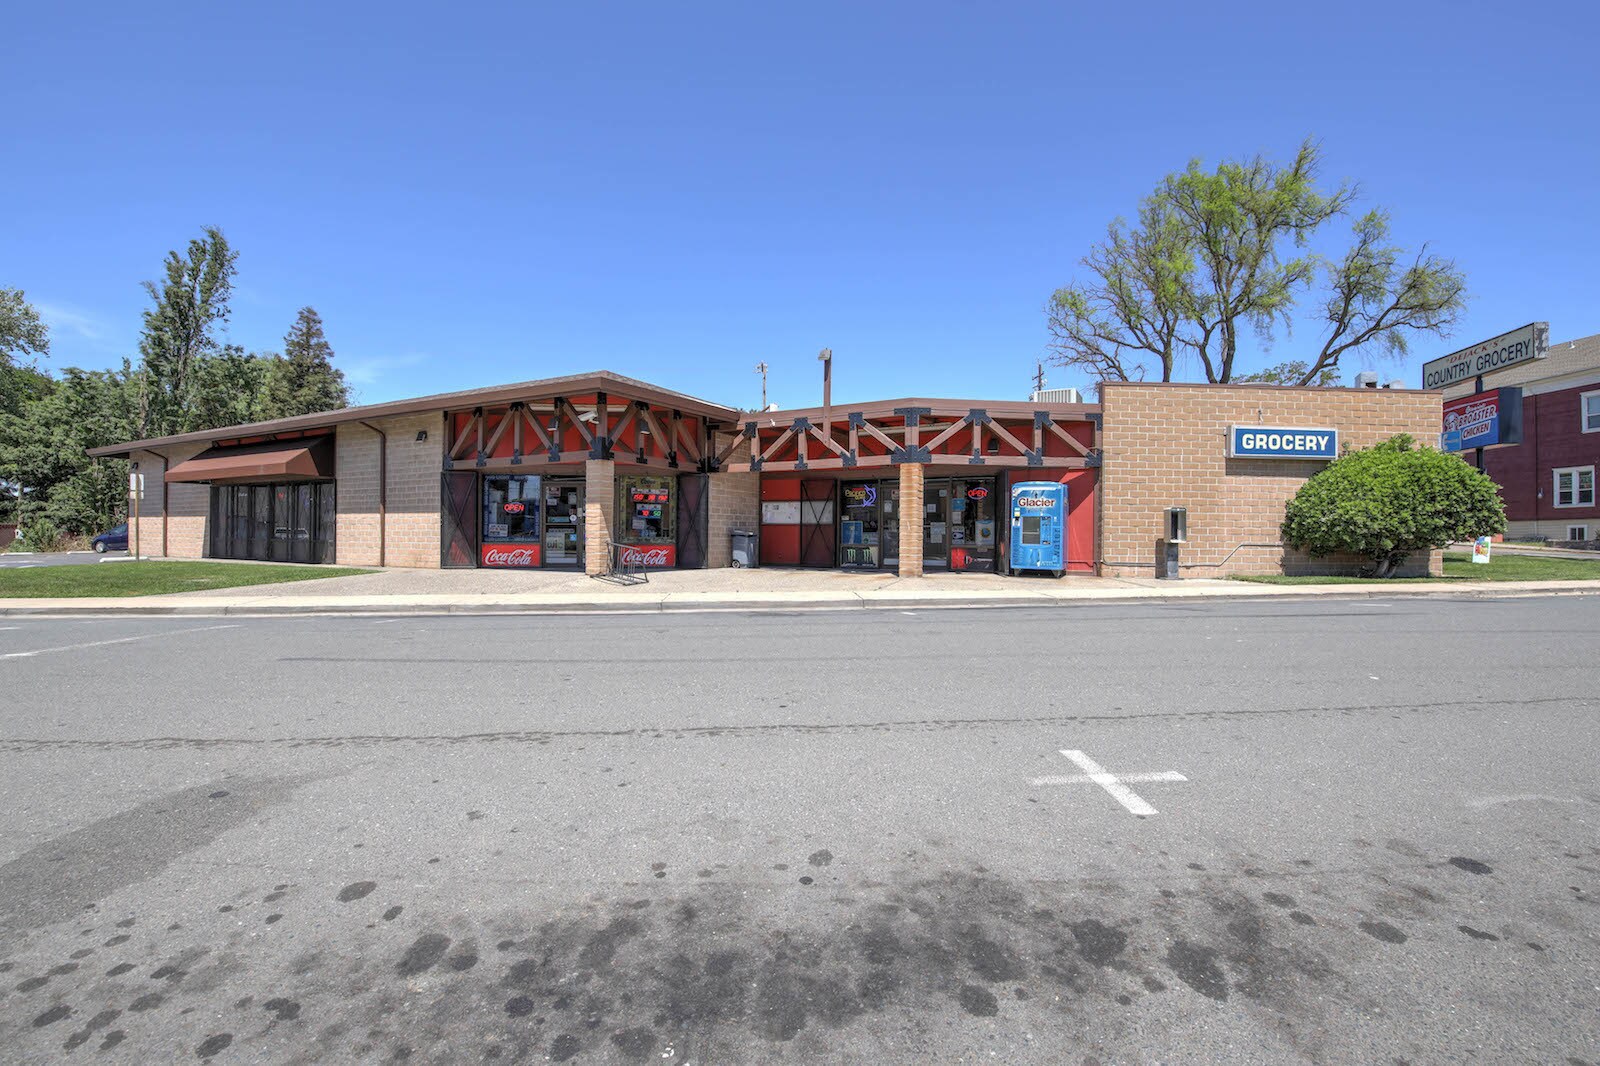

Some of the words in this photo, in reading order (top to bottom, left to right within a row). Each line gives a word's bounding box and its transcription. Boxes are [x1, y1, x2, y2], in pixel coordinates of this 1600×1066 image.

[1427, 360, 1472, 387] COUNTRY
[1476, 339, 1531, 371] GROCERY
[1458, 406, 1496, 427] BROASTER
[1463, 422, 1490, 438] CHICKEN
[1242, 433, 1329, 451] GROCERY
[967, 489, 988, 497] OPEN
[504, 503, 524, 511] OPEN
[1018, 497, 1056, 507] Glacier
[485, 549, 534, 565] Coca-Cola
